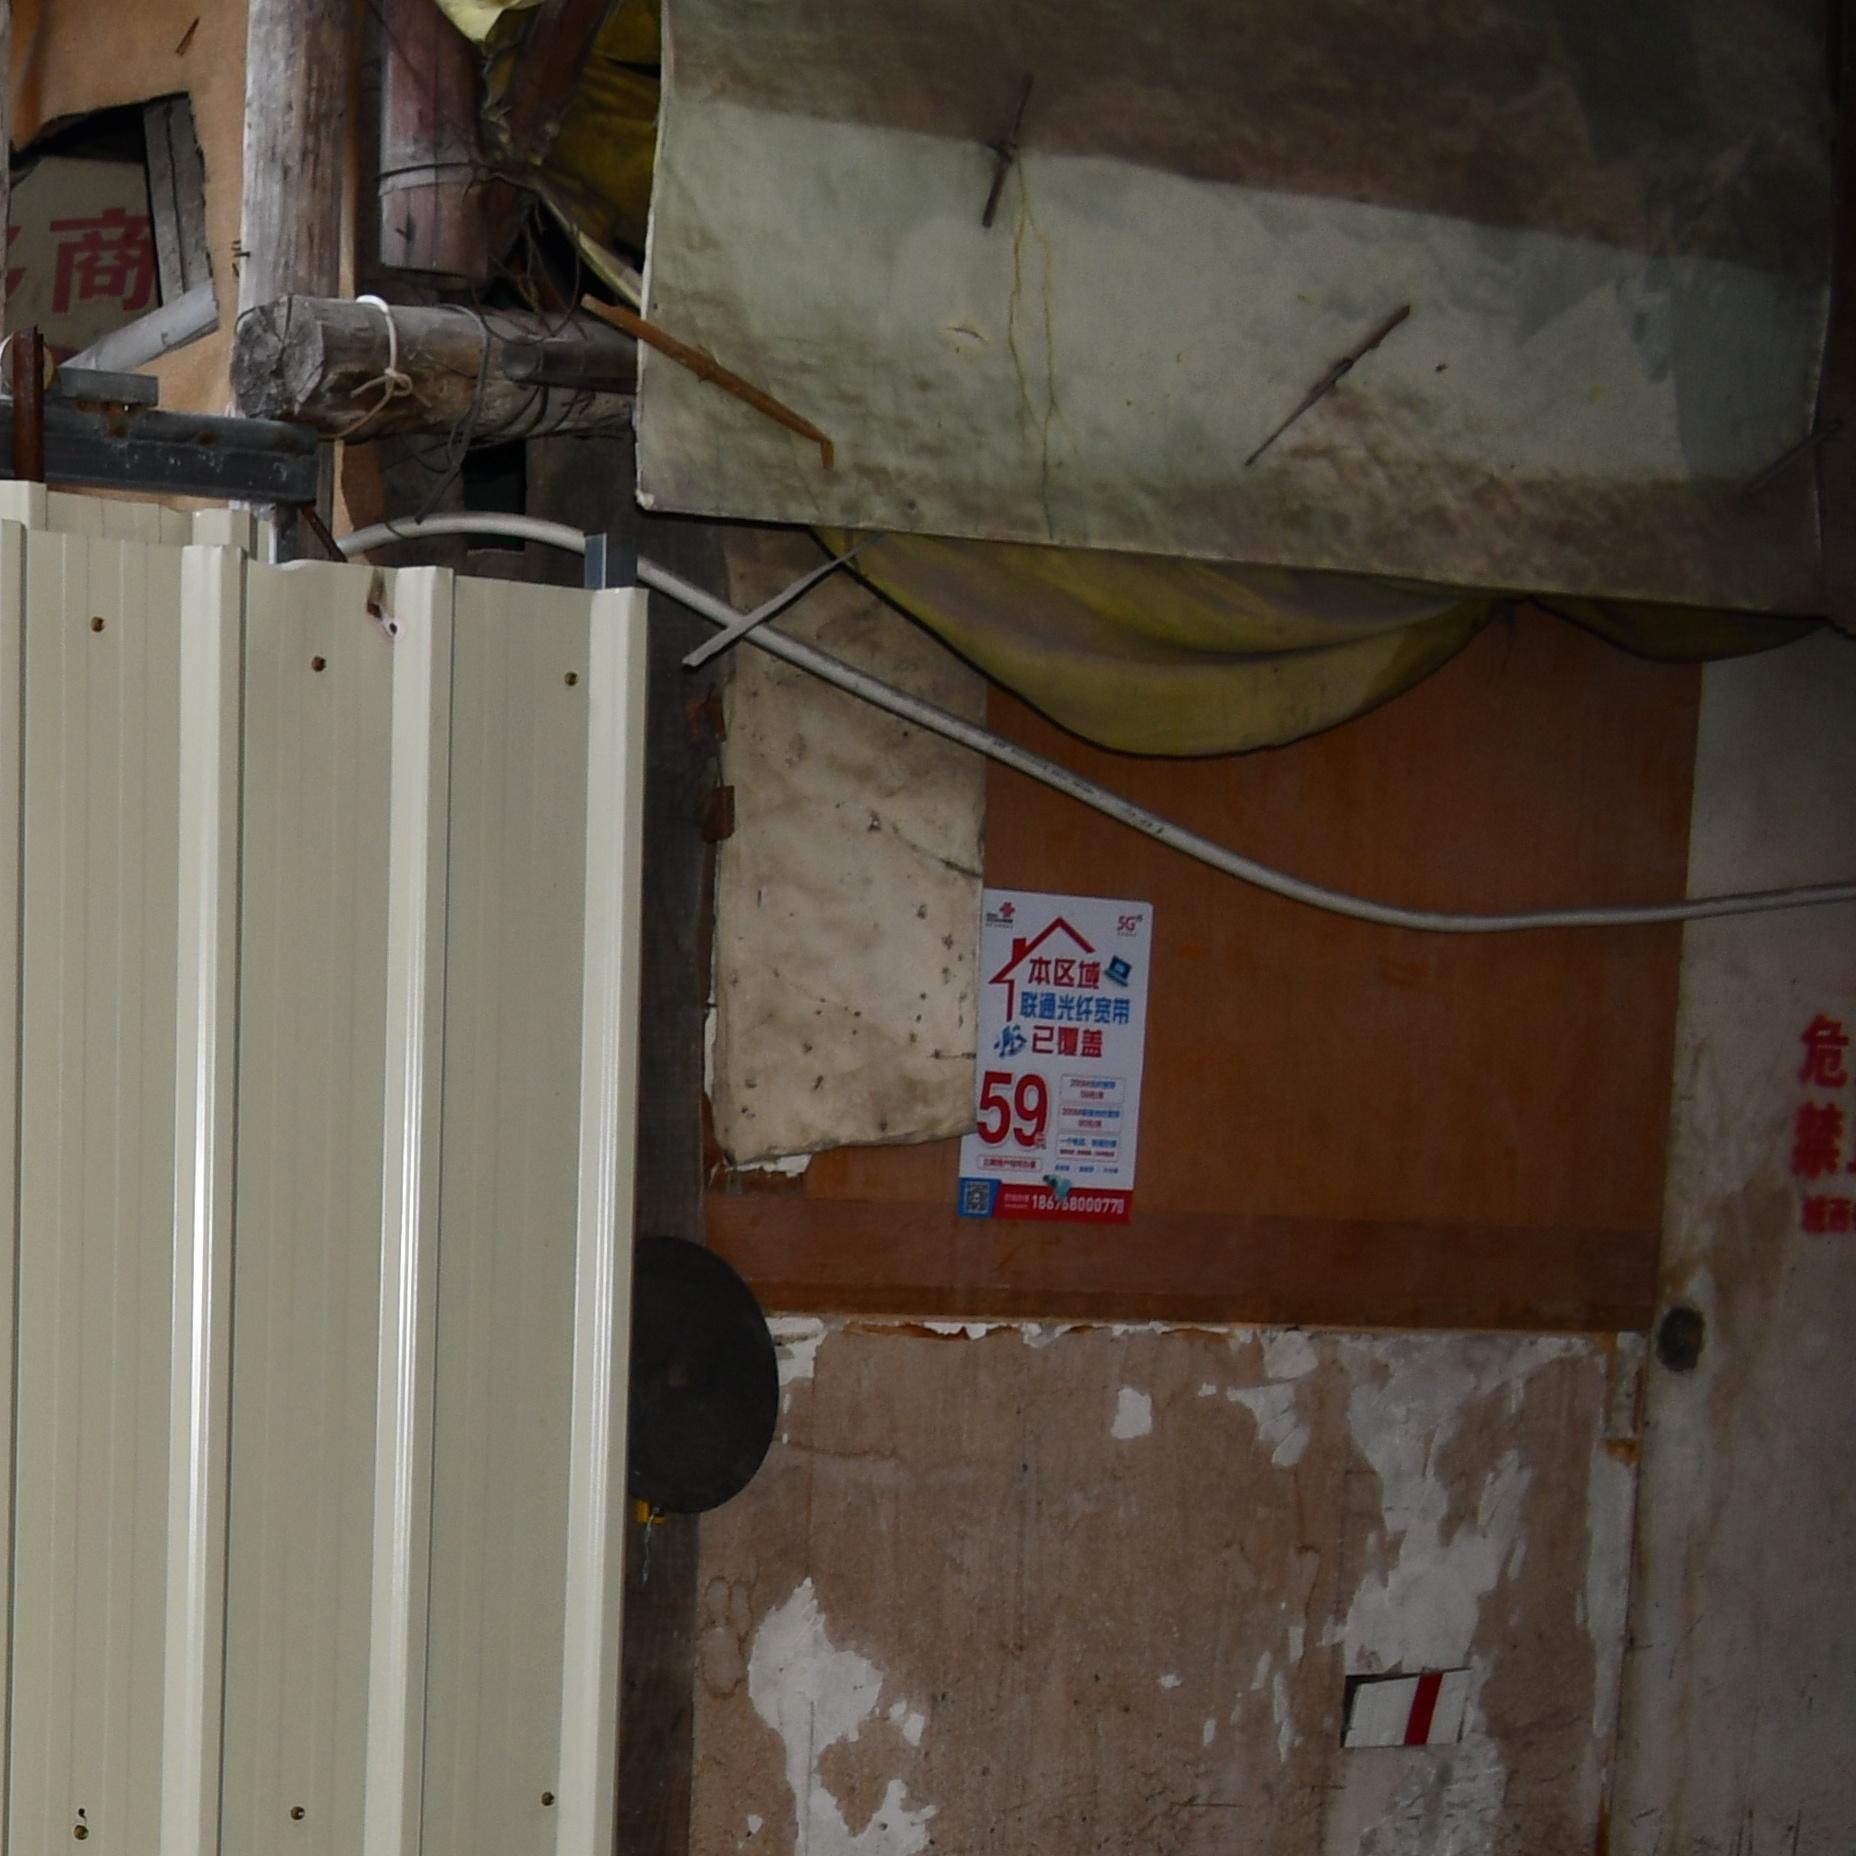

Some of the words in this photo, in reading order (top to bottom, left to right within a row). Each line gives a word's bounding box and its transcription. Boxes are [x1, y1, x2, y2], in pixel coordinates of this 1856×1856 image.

[1028, 956, 1101, 989] 本区域
[1019, 991, 1130, 1024] 联通光纤宽带
[977, 1071, 1048, 1147] 59
